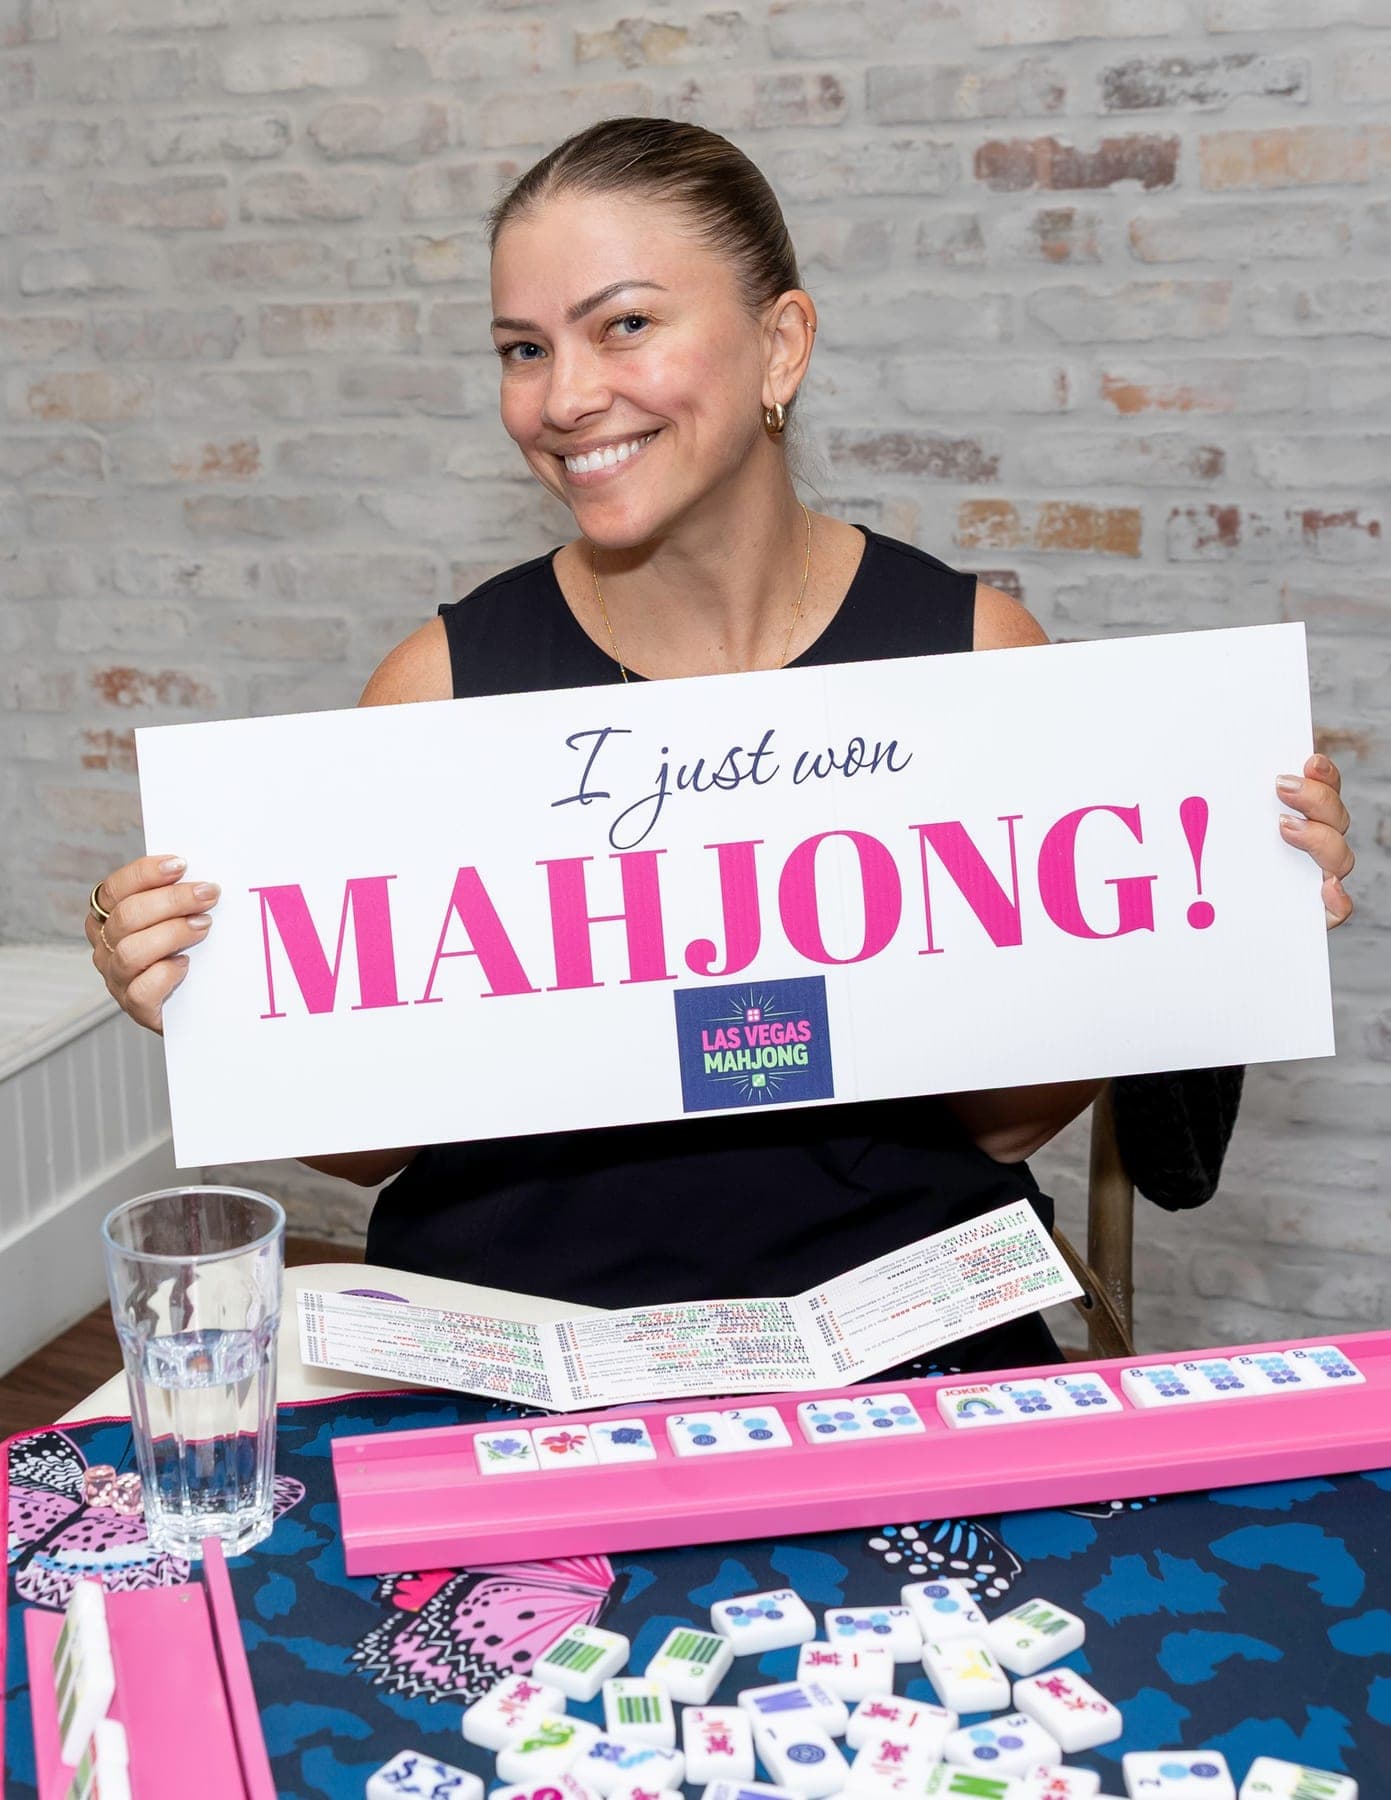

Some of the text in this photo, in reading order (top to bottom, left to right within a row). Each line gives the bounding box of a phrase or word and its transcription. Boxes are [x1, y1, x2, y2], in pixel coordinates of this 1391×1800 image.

[551, 726, 913, 850] I just won
[249, 795, 1217, 1019] MAHJONG!
[701, 1020, 812, 1051] LAS VEGAS
[704, 1043, 809, 1074] MAHJONG
[1292, 1349, 1308, 1360] 8
[1239, 1355, 1254, 1366] 8
[1183, 1362, 1198, 1372] 8
[1129, 1368, 1144, 1378] 8
[1053, 1376, 1067, 1387] 6
[943, 1384, 991, 1398] JOKER
[999, 1383, 1012, 1393] 6
[804, 1402, 819, 1412] 4
[861, 1397, 875, 1407] 4
[673, 1416, 689, 1426] 2
[729, 1410, 744, 1421] 2
[773, 1591, 793, 1602] 5
[889, 1608, 910, 1618] 5
[963, 1610, 979, 1623] 2
